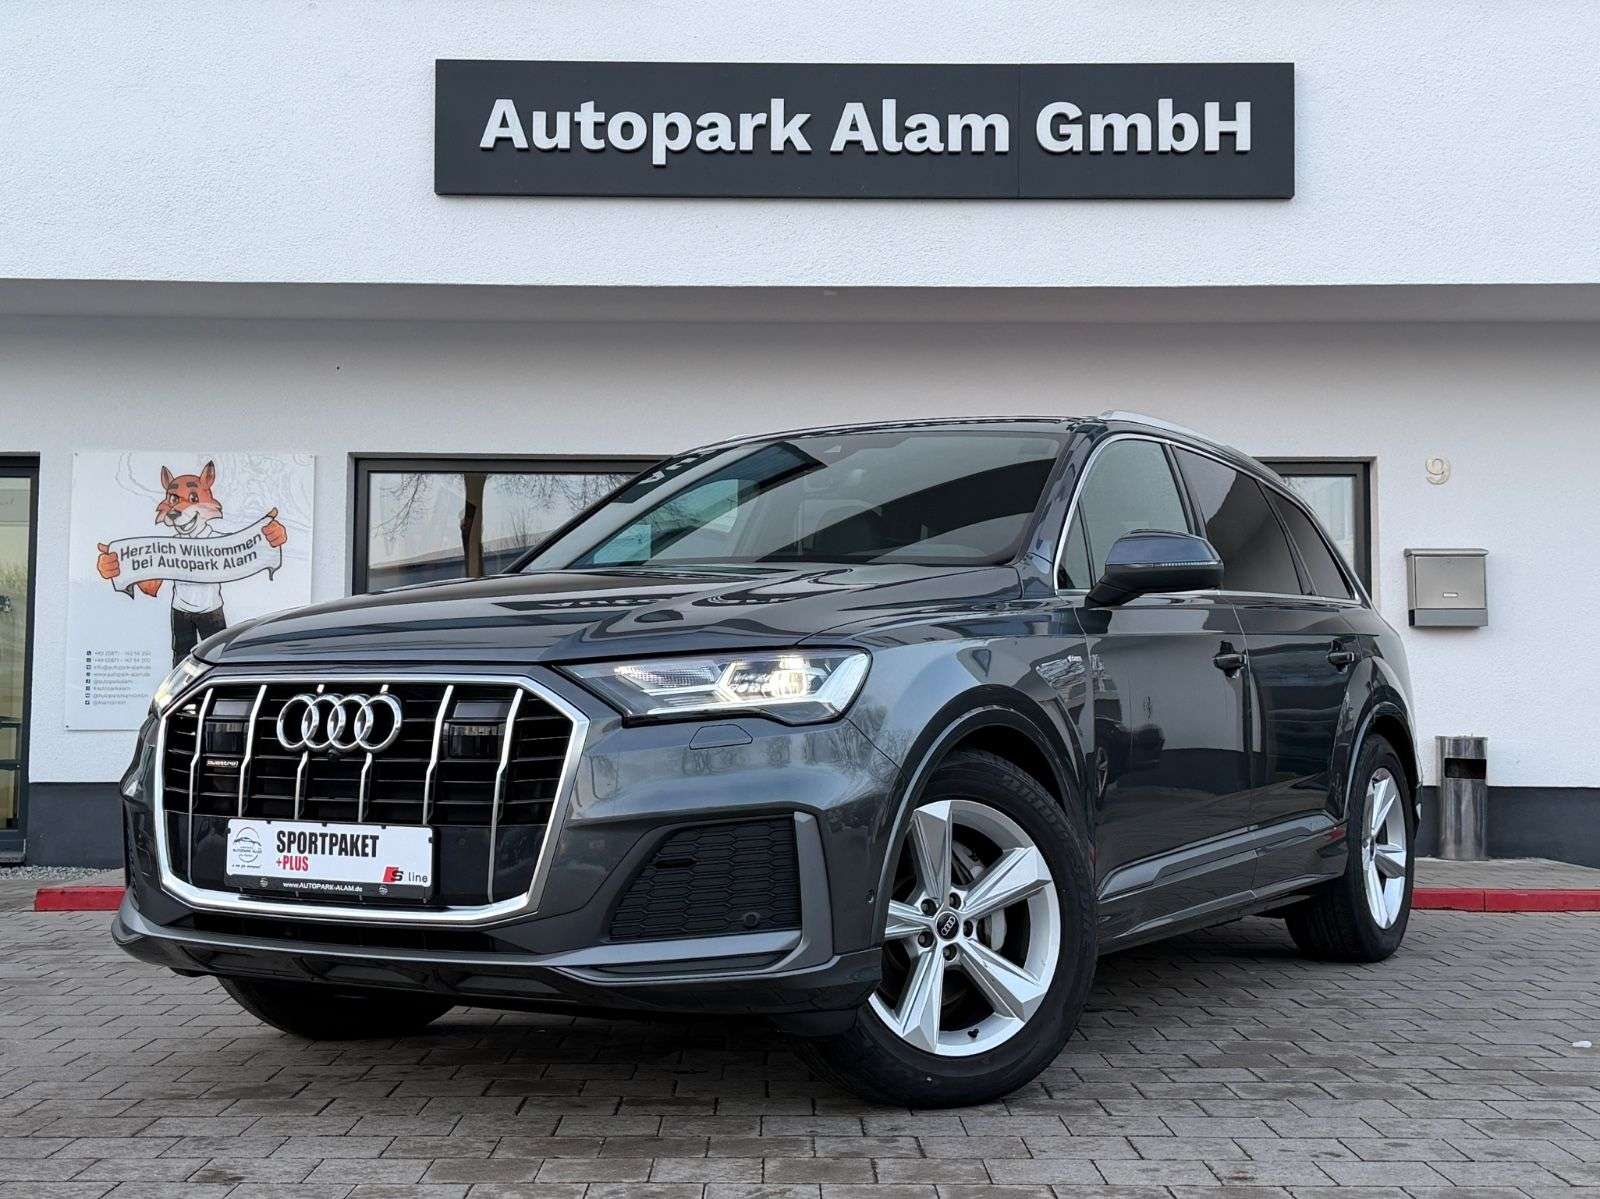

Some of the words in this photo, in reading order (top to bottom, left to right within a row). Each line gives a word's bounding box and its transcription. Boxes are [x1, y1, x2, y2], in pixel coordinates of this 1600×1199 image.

[478, 98, 813, 167] Autopark
[829, 98, 1010, 154] Alam
[1035, 98, 1252, 154] GmbH
[1425, 458, 1451, 485] 9
[120, 542, 177, 562] Herzlich
[180, 533, 262, 558] Willkommen
[132, 556, 153, 571] bei
[158, 555, 219, 572] Autopark
[223, 551, 258, 570] Alam
[276, 830, 380, 858] SPORTPAKET
[276, 855, 309, 872] +PLUS
[408, 872, 428, 883] line
